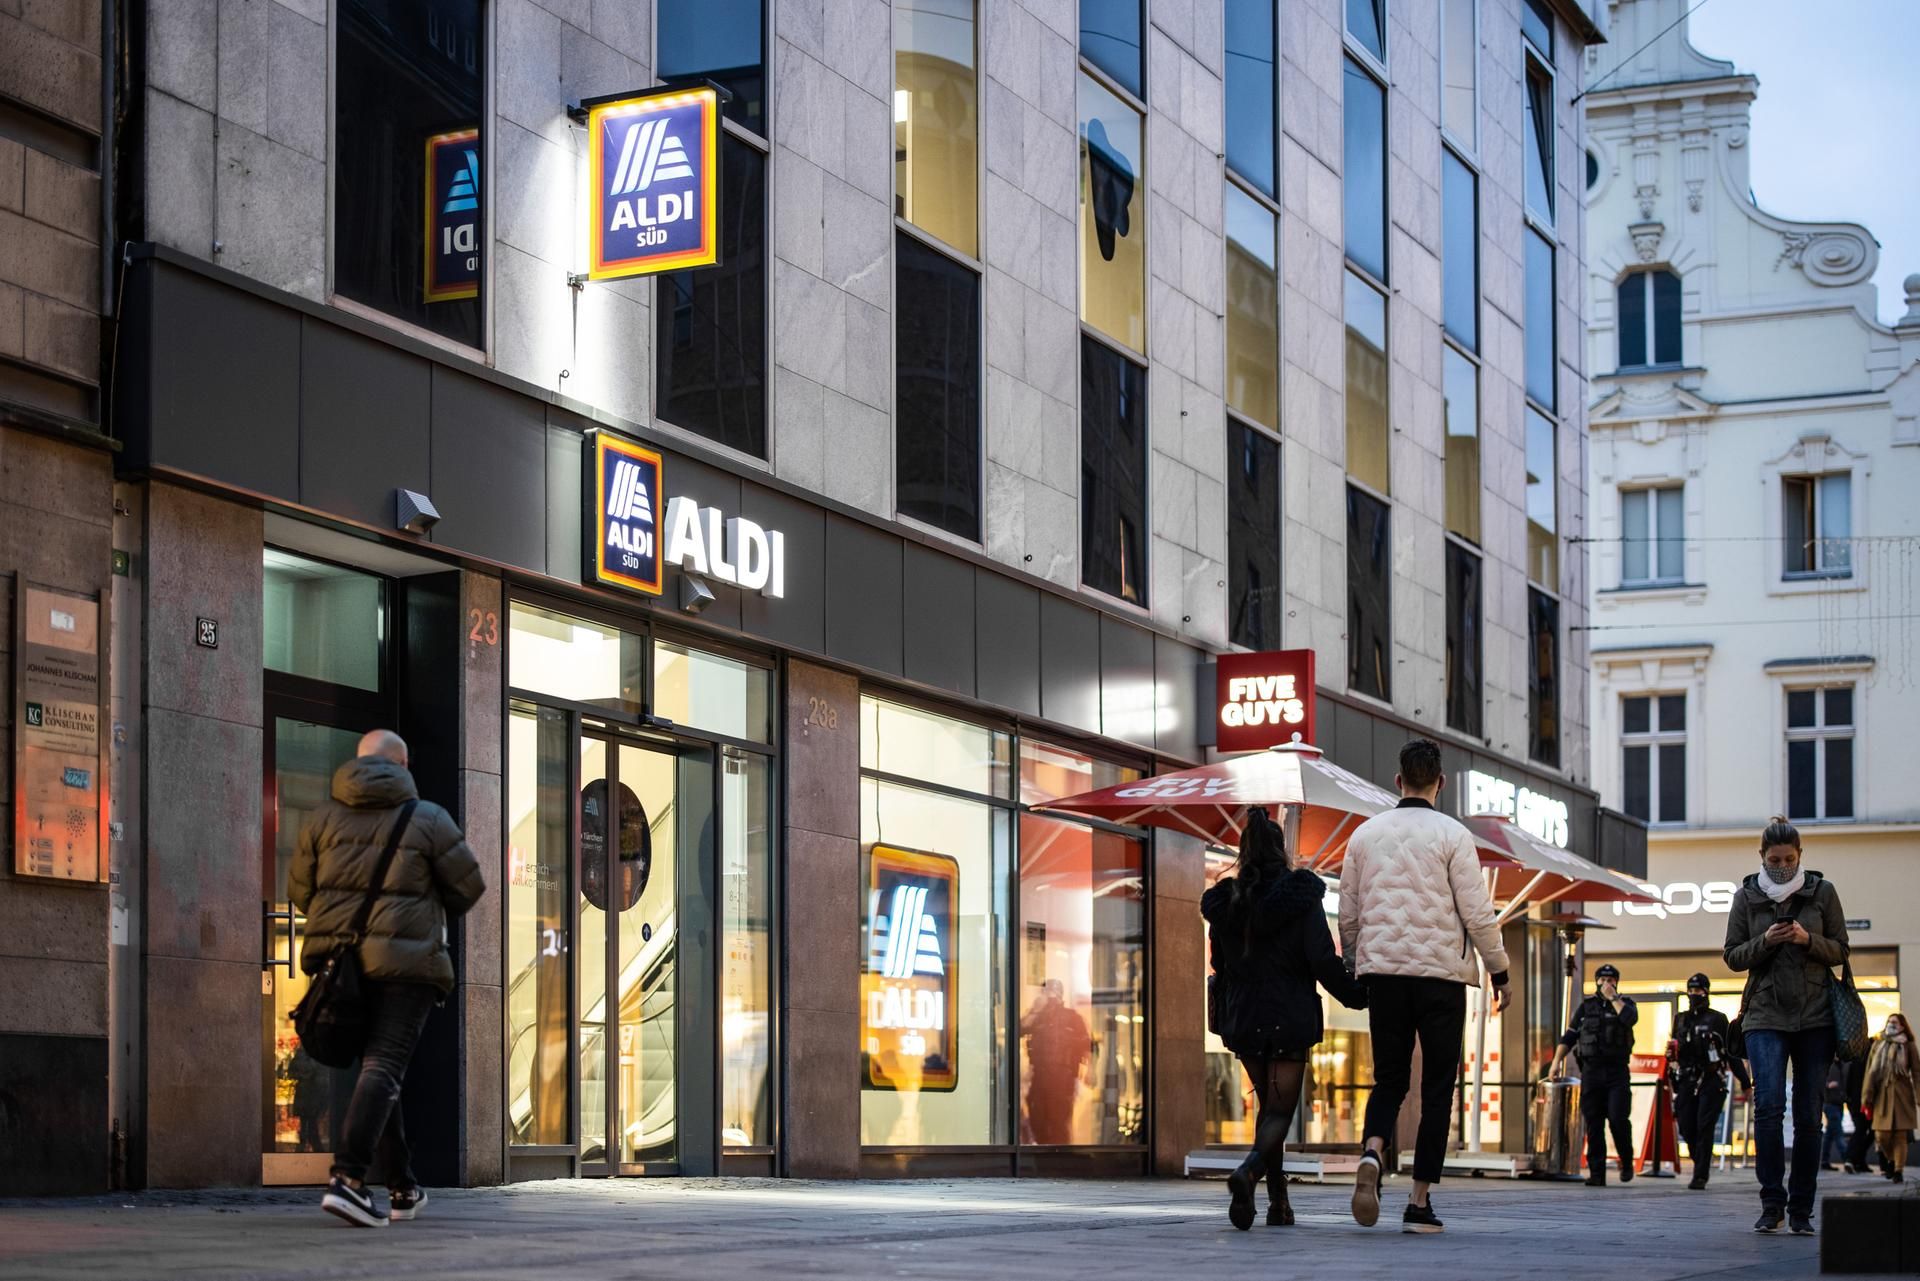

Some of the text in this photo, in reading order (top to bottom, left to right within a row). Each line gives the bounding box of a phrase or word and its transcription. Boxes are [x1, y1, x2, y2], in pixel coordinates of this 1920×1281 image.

[610, 191, 694, 231] ALDI
[636, 228, 668, 247] SÜD
[607, 521, 653, 558] ALDI
[665, 496, 784, 599] ALDI
[622, 552, 639, 569] SÜD
[200, 621, 216, 645] 25
[469, 608, 498, 646] 23
[27, 663, 63, 678] JOHANNES
[1229, 674, 1296, 702] FIVE
[45, 705, 95, 722] KLISCHAN
[45, 717, 95, 734] CONSULTING
[808, 696, 838, 729] 23a
[1221, 698, 1304, 727] GUYS
[884, 986, 944, 1030] ALDI
